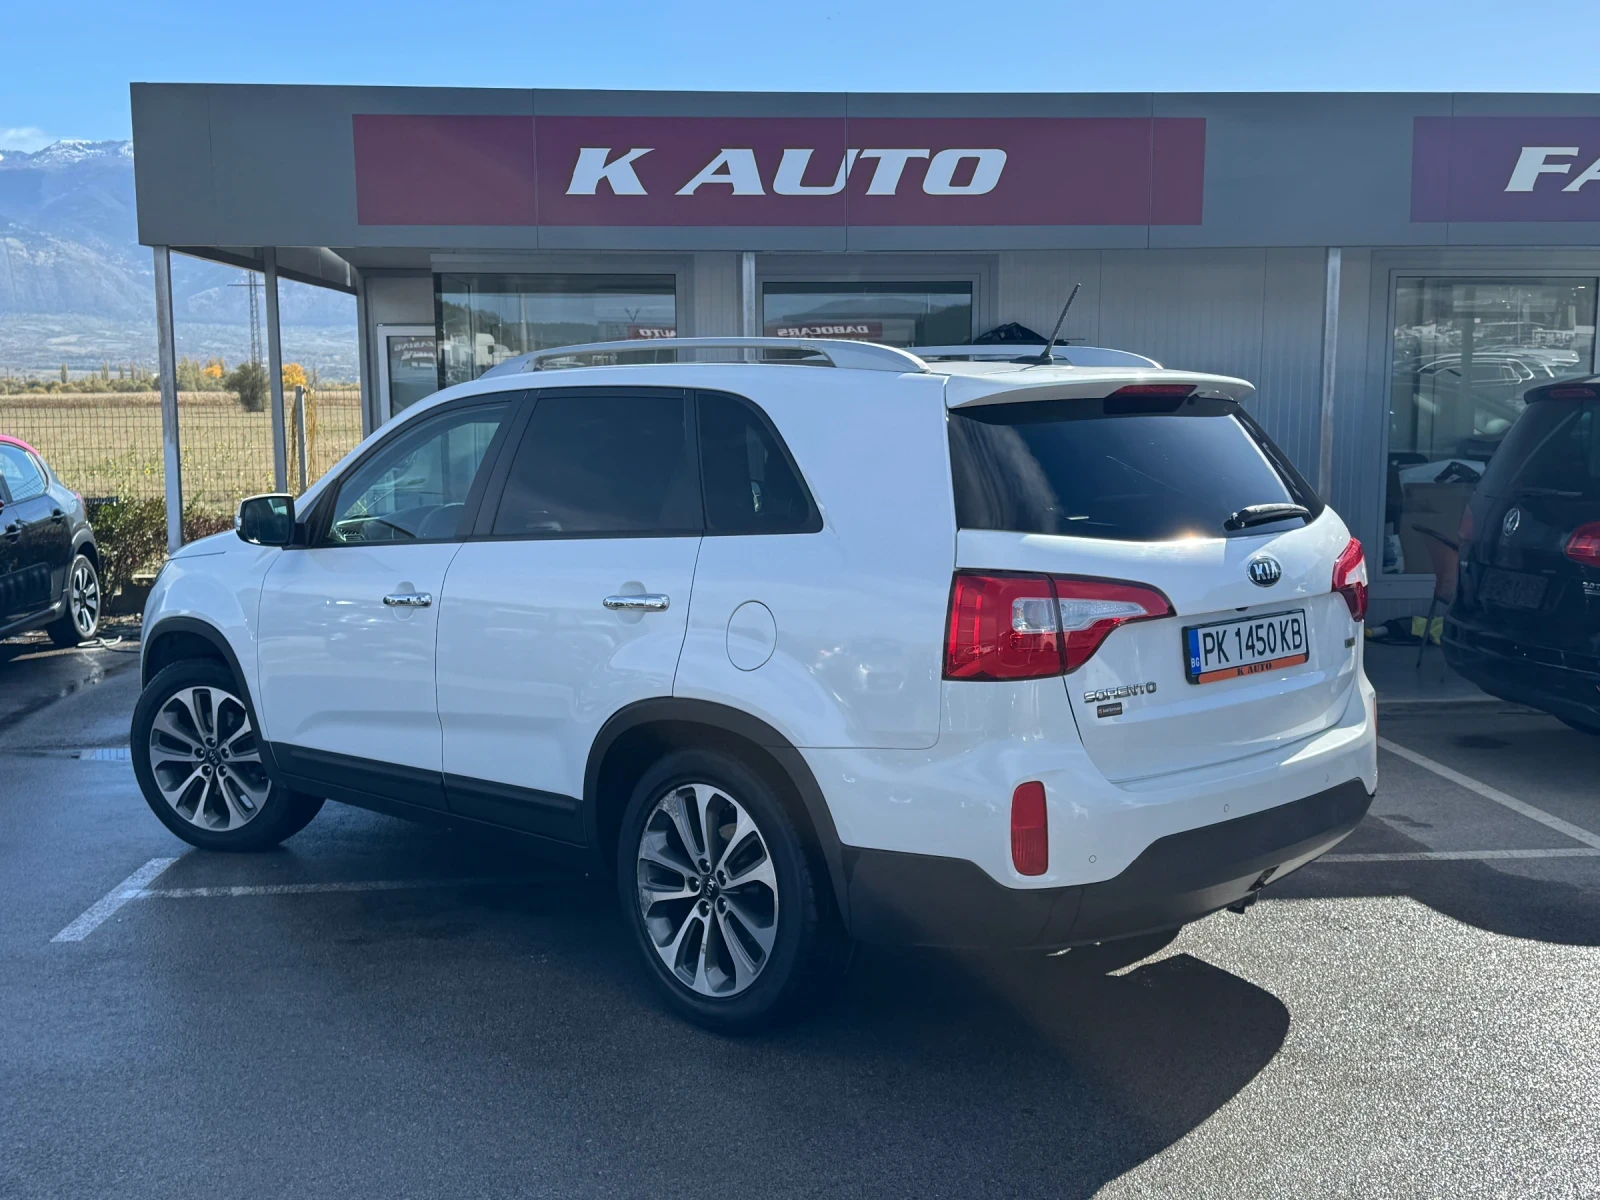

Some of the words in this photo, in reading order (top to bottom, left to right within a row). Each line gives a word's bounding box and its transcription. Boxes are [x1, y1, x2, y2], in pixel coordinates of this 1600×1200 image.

[565, 148, 655, 195] K
[674, 148, 1007, 196] AUTO
[1253, 561, 1279, 581] KIA
[1202, 629, 1230, 667] PK
[1235, 622, 1277, 660] 1450
[1280, 618, 1303, 652] KB
[1191, 657, 1200, 668] BG
[1237, 668, 1244, 676] K
[1247, 662, 1272, 675] AUTO
[1084, 681, 1157, 704] SORENTO
